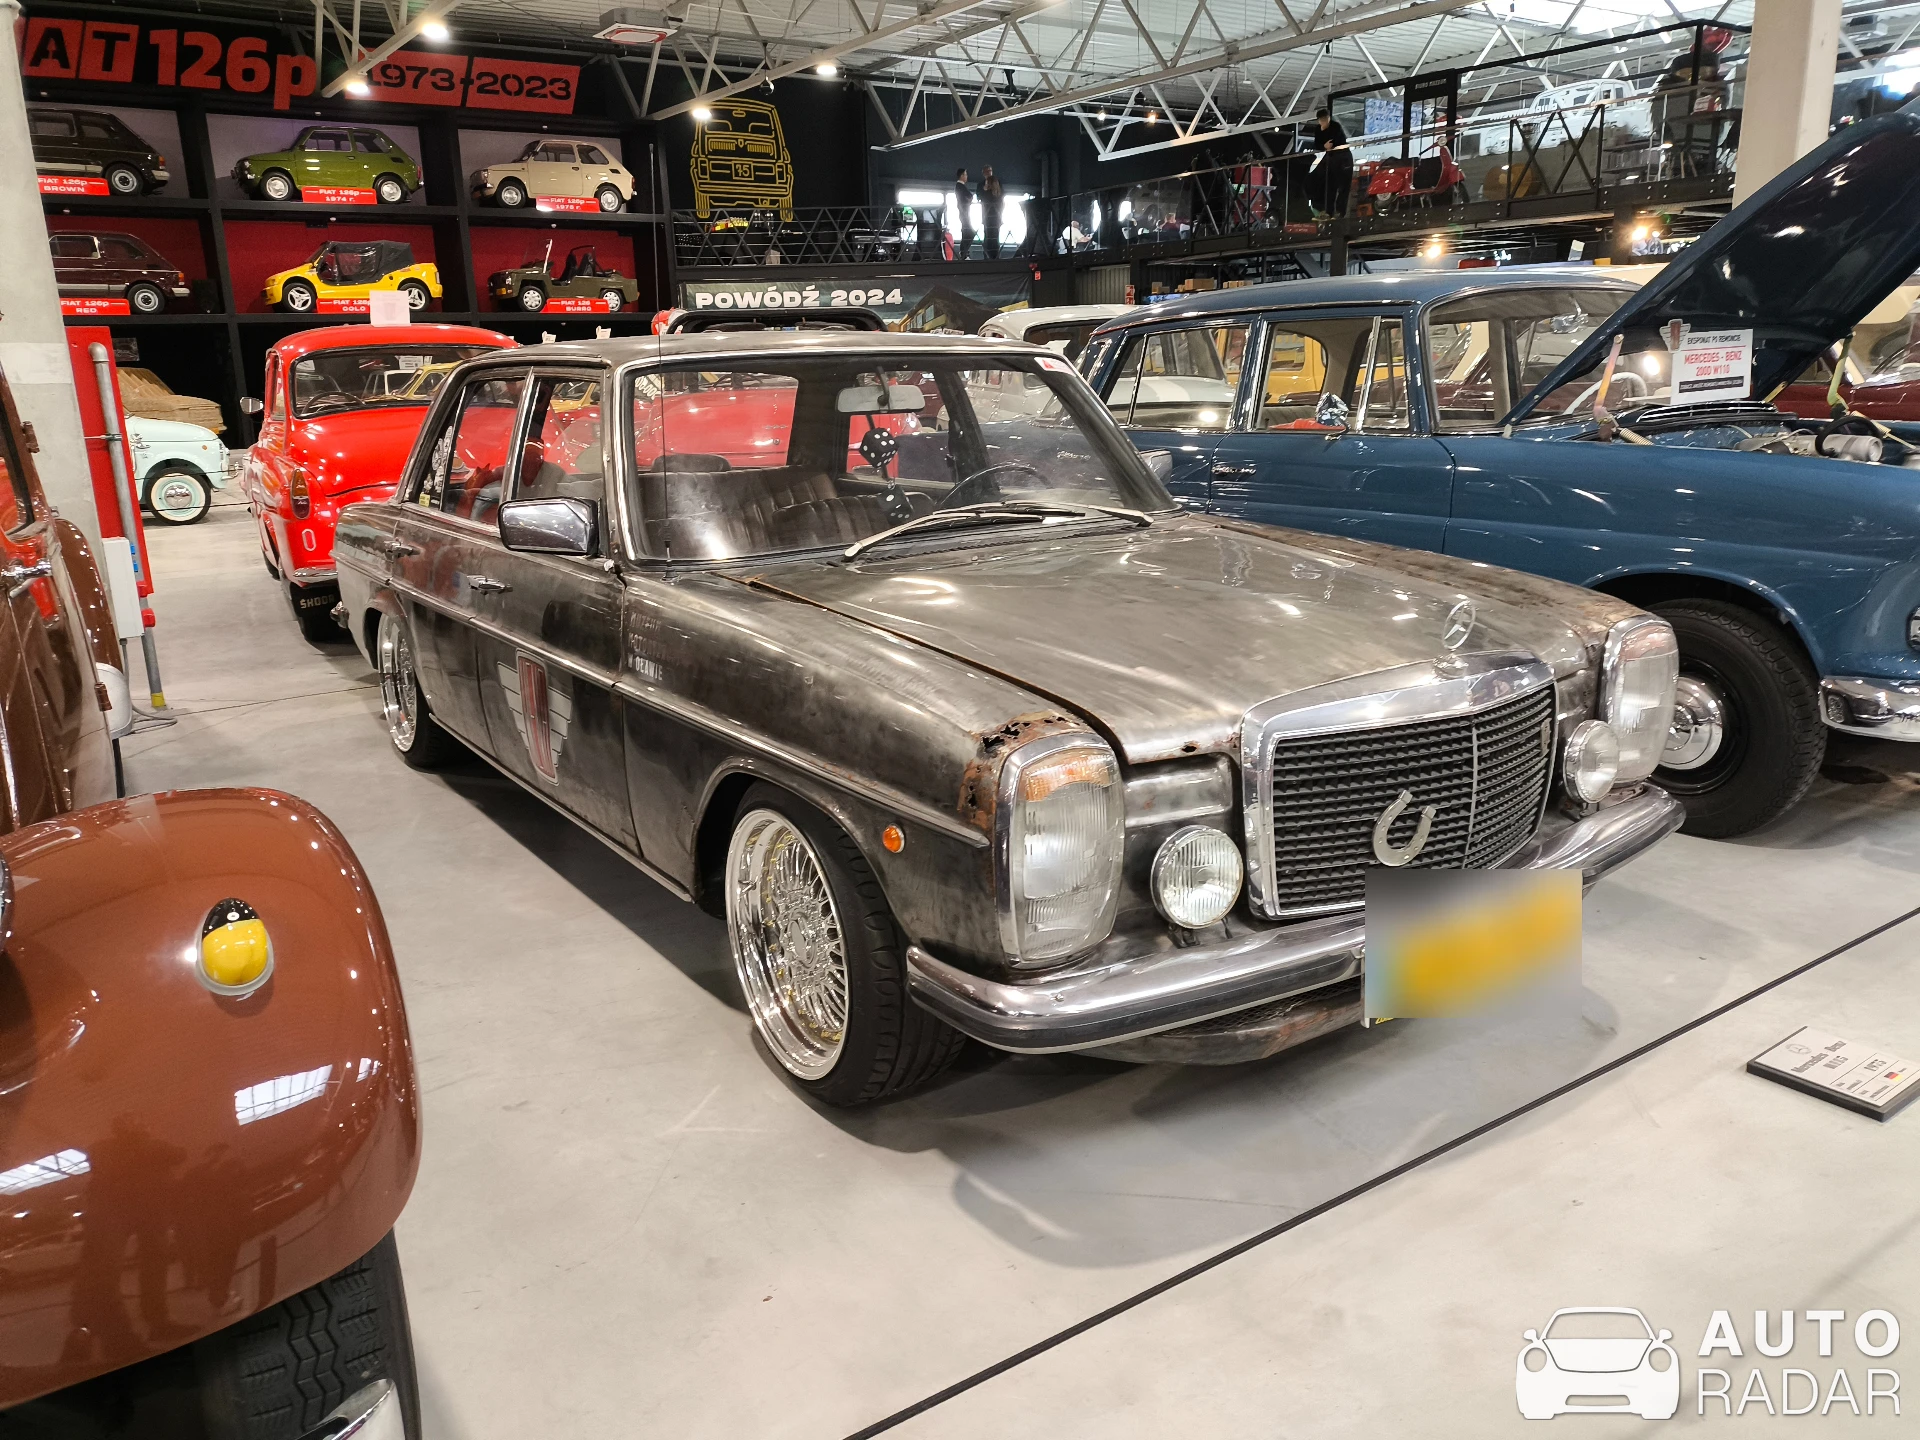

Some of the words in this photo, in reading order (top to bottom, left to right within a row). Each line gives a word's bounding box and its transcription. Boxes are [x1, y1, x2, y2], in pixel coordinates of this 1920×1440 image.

[29, 26, 131, 72] AT
[150, 29, 317, 110] 126p
[695, 285, 821, 309] POWÓDŹ
[830, 288, 903, 307] 2024
[1684, 352, 1720, 365] MERCEDES
[1725, 350, 1742, 362] BENZ
[1713, 364, 1730, 375] W110
